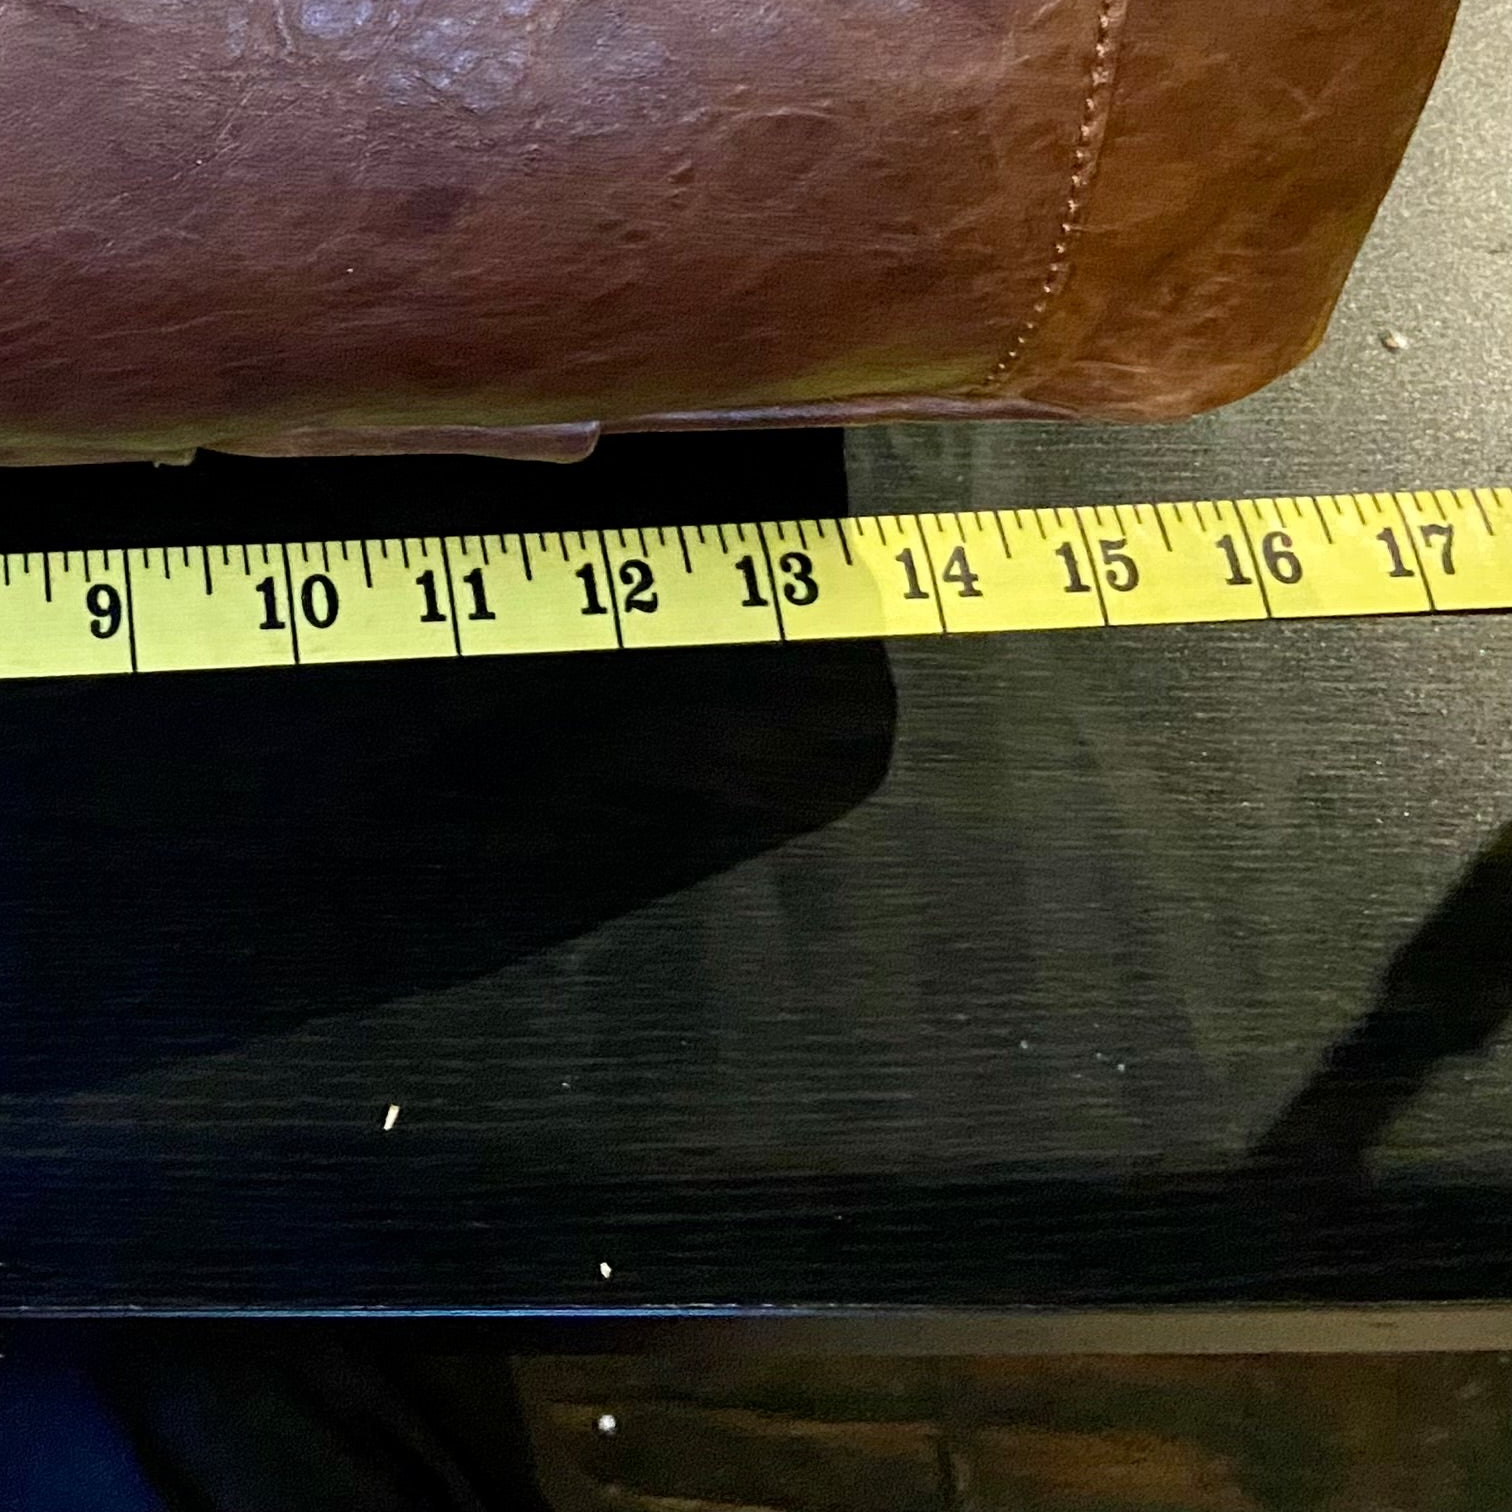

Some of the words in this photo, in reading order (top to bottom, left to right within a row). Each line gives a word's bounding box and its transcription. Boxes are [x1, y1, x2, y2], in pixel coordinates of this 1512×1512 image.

[87, 584, 121, 639] 9
[255, 574, 339, 631] 10
[416, 567, 495, 623] 11
[575, 559, 659, 615] 12
[735, 551, 819, 607] 13
[896, 545, 982, 599] 14
[1056, 538, 1140, 593] 15
[1216, 531, 1303, 585] 16
[1378, 524, 1456, 577] 17
